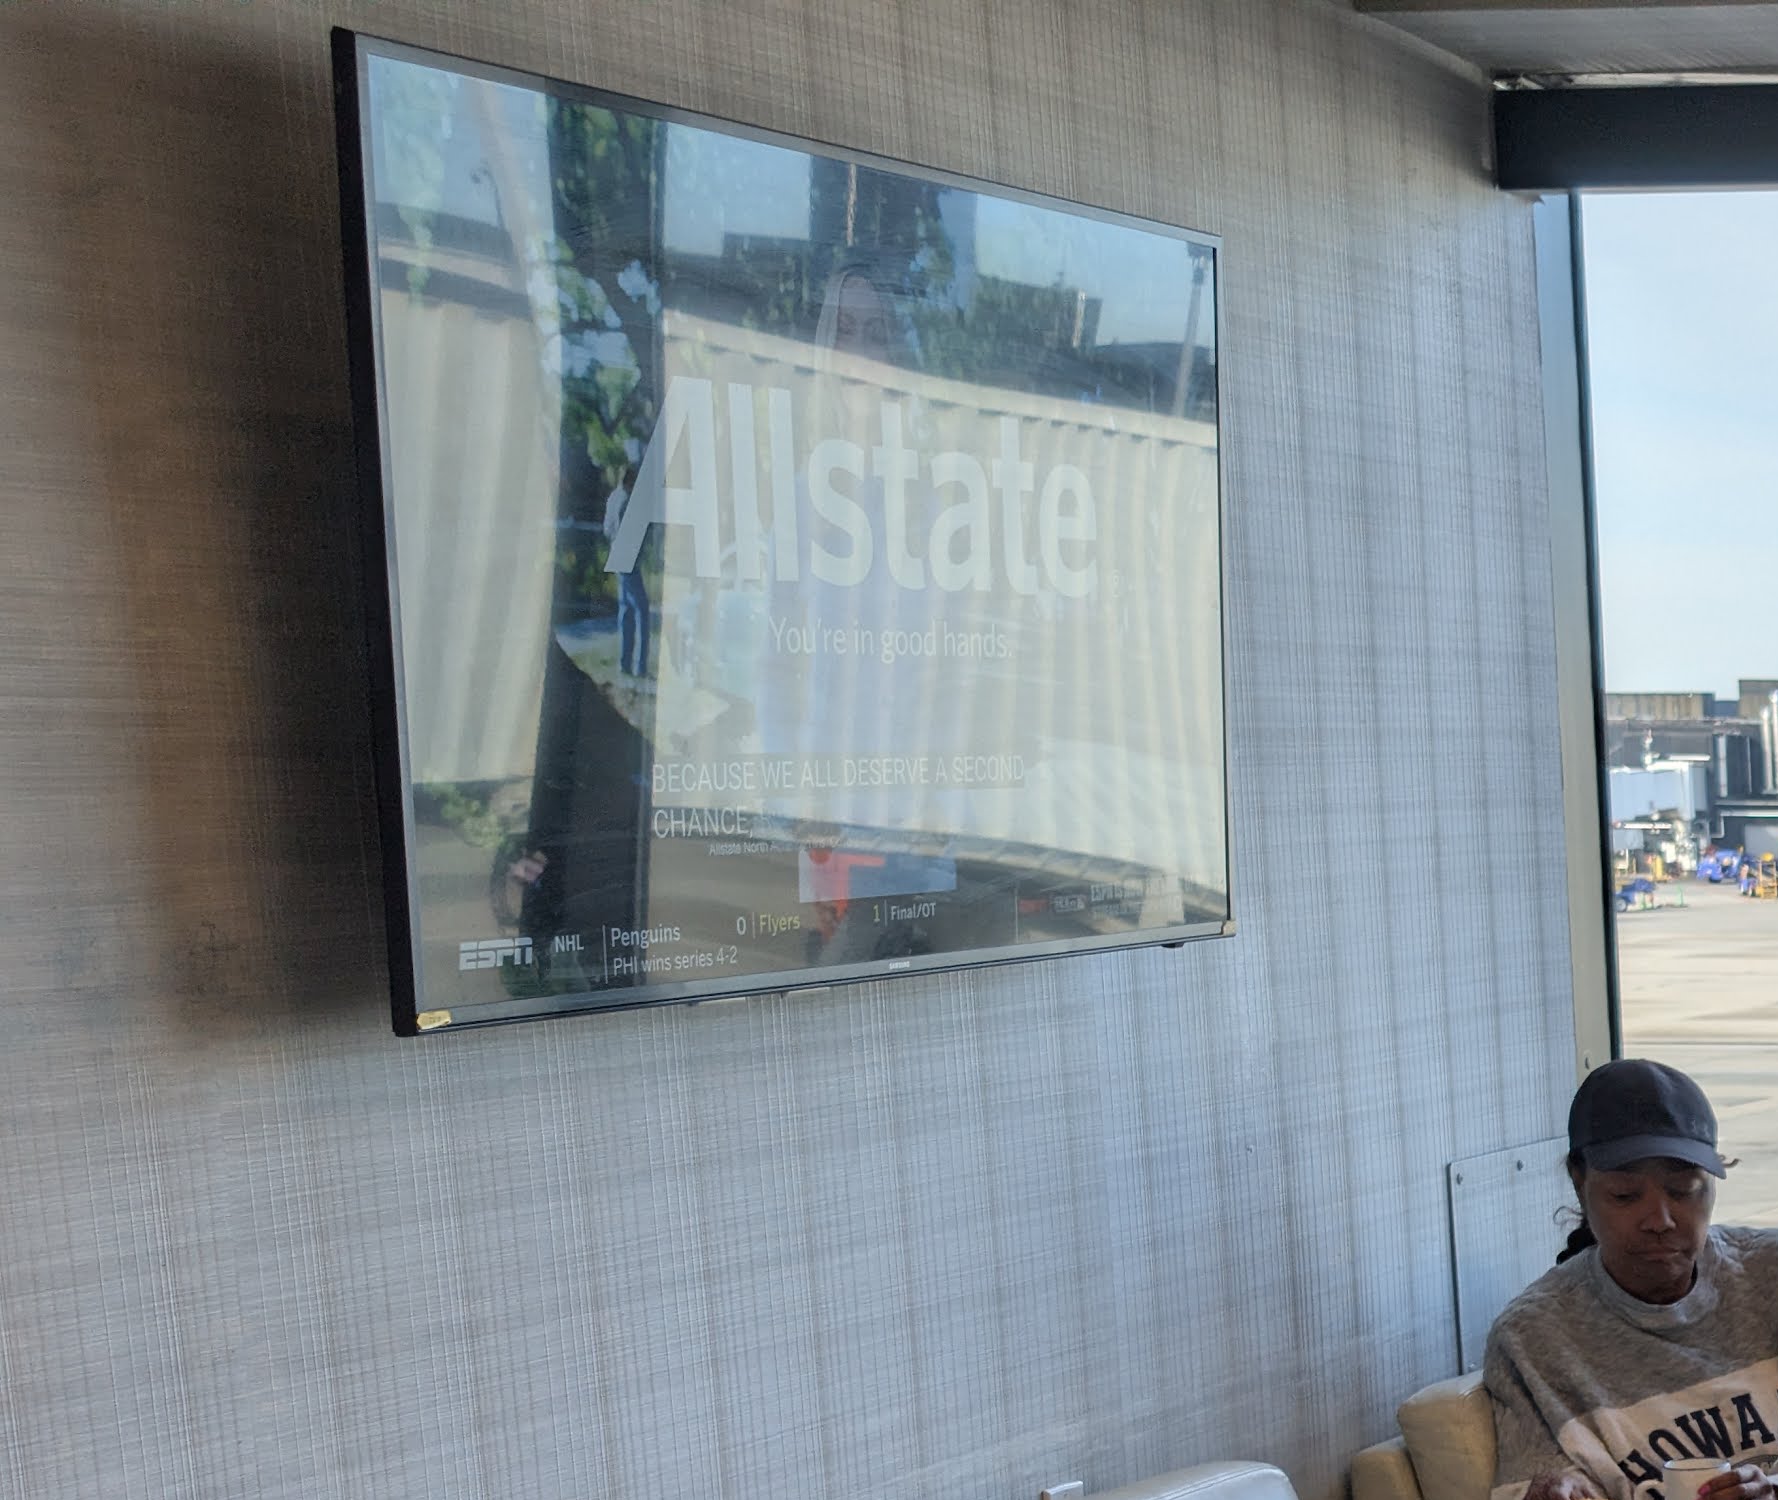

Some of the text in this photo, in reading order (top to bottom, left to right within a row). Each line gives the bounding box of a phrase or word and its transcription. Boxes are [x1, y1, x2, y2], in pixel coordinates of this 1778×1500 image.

[603, 375, 1098, 598] Allstate
[768, 615, 1013, 664] You're in good hands.
[651, 754, 1025, 793] BECAUSE WE ALL DESERVE A SECOND
[652, 804, 754, 840] CHANCE,
[758, 904, 881, 938] Flyers 1
[889, 901, 937, 922] Final/OT
[553, 935, 585, 953] NHL
[610, 916, 747, 951] Penguins 0
[459, 936, 534, 972] ESPN
[613, 946, 738, 977] PHI wins series 4-2
